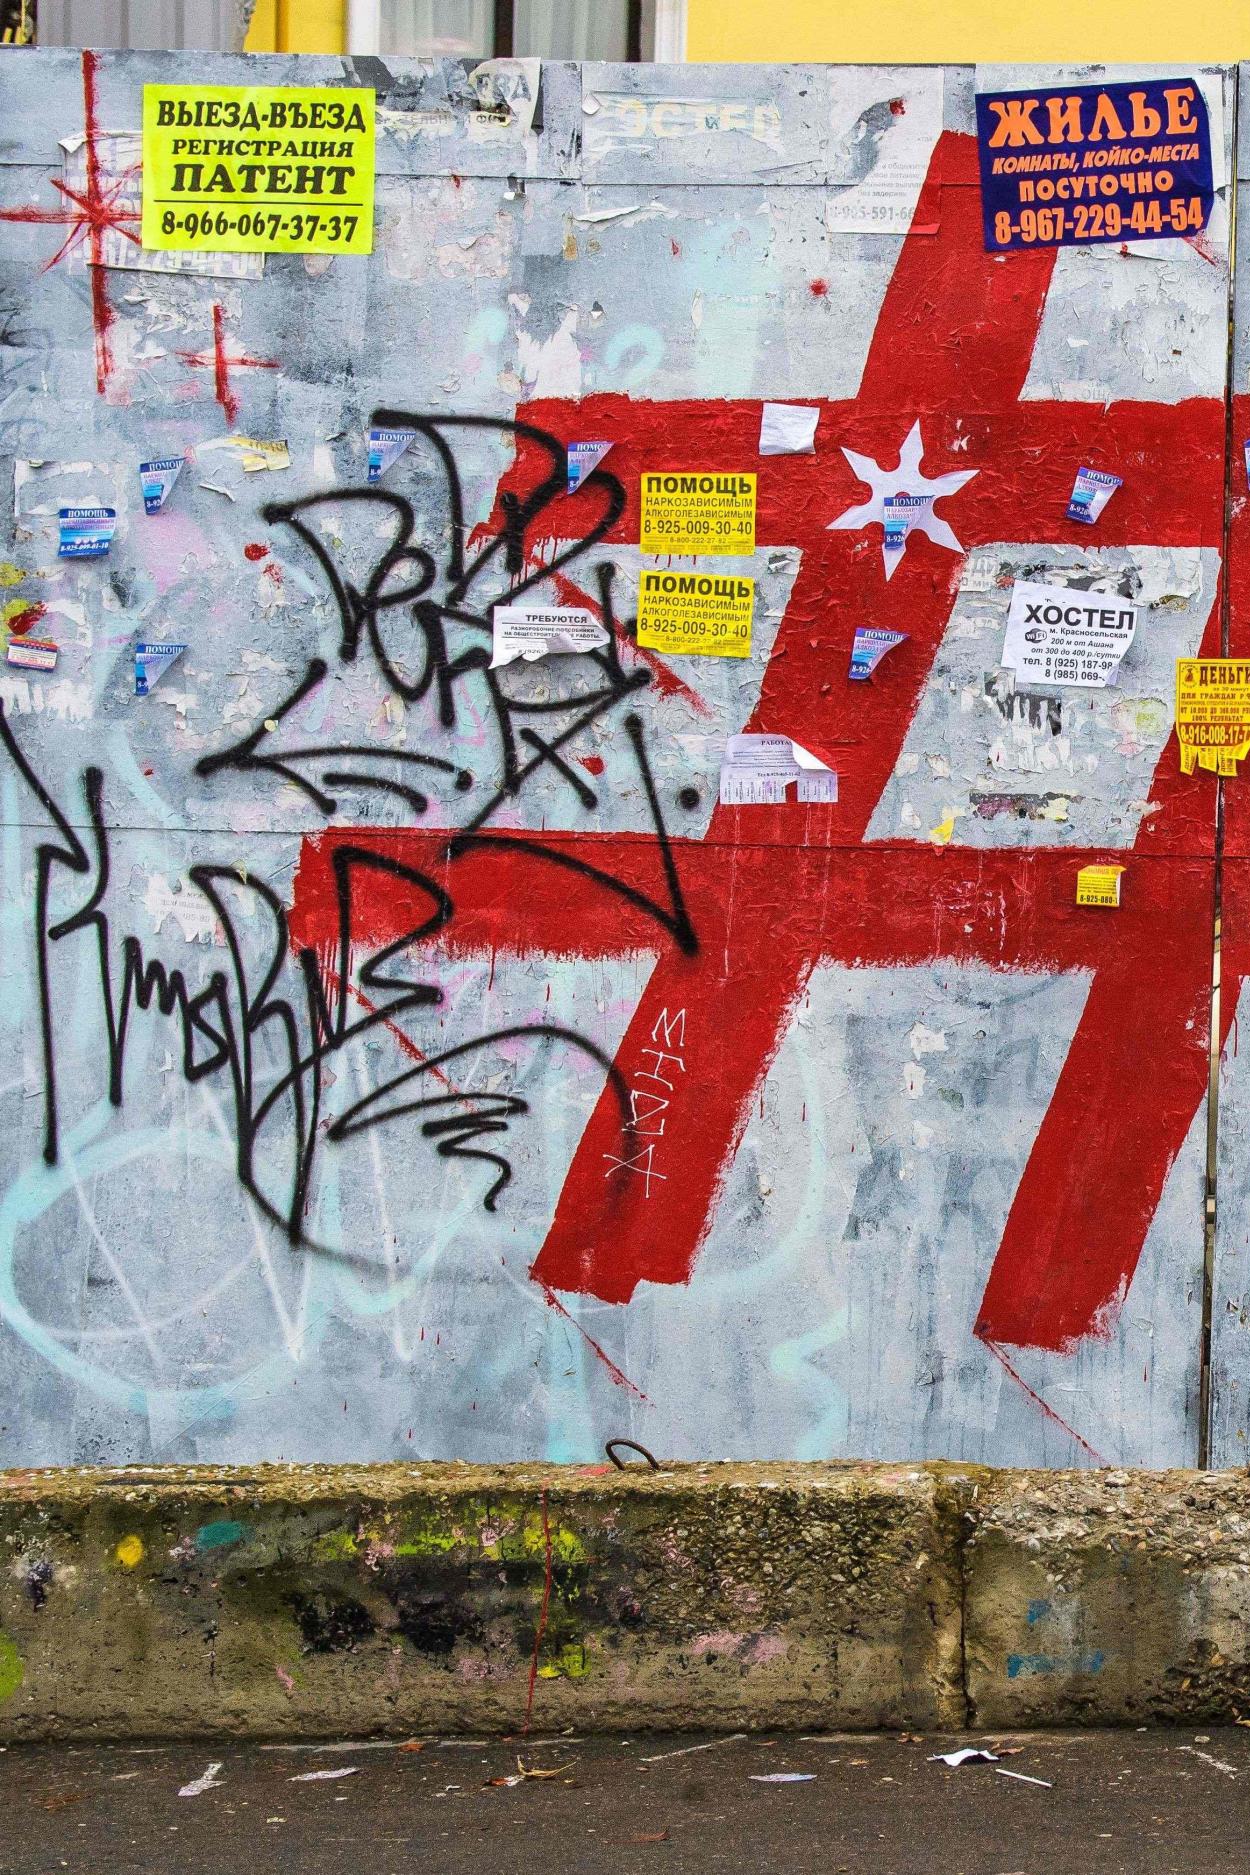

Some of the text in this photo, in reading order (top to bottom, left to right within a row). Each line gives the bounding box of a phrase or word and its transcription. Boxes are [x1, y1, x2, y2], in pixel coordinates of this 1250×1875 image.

[157, 100, 366, 133] ВЫЕЗД-ВЪЕЗД
[988, 87, 1198, 148] ЖИЛЬЕ
[171, 139, 354, 159] РЕГИСТРАЦИЯ
[991, 143, 1199, 174] КОМНАТЫ, КОЙКО-МЕСТА
[170, 164, 355, 194] ПАТЕНТ
[1019, 170, 1174, 202] ПОСУТОЧНО
[161, 211, 358, 242] 8-966-067-37-37
[994, 197, 1204, 244] 8-967-229-44-54
[647, 477, 752, 497] ПОМОЩЬ
[646, 498, 752, 507] НАРКОЗАВИСИМЫМ
[68, 509, 109, 518] ПОМОЩЬ
[646, 510, 752, 518] АЛКОГОЛЕЗАВИСИМЫМ
[645, 520, 752, 535] 8-925-009-30-40
[646, 575, 750, 601] ПОМОЩЬ
[644, 595, 750, 612] НАРКОЗАВИСИМЫМ
[526, 615, 588, 624] ТРЕБУЮТСЯ
[1024, 604, 1134, 630] ХОСТЕЛ
[640, 618, 748, 638] 8-925-009-30-40
[1061, 628, 1128, 639] Красносельская
[1045, 647, 1059, 655] 300
[1061, 648, 1071, 656] до
[1072, 649, 1086, 657] 400
[1088, 640, 1114, 649] Ашана
[1024, 657, 1043, 666] тел.
[1046, 657, 1052, 666] 8
[1054, 658, 1079, 669] (925)
[1045, 669, 1051, 678] 8
[1054, 670, 1078, 681] (985)
